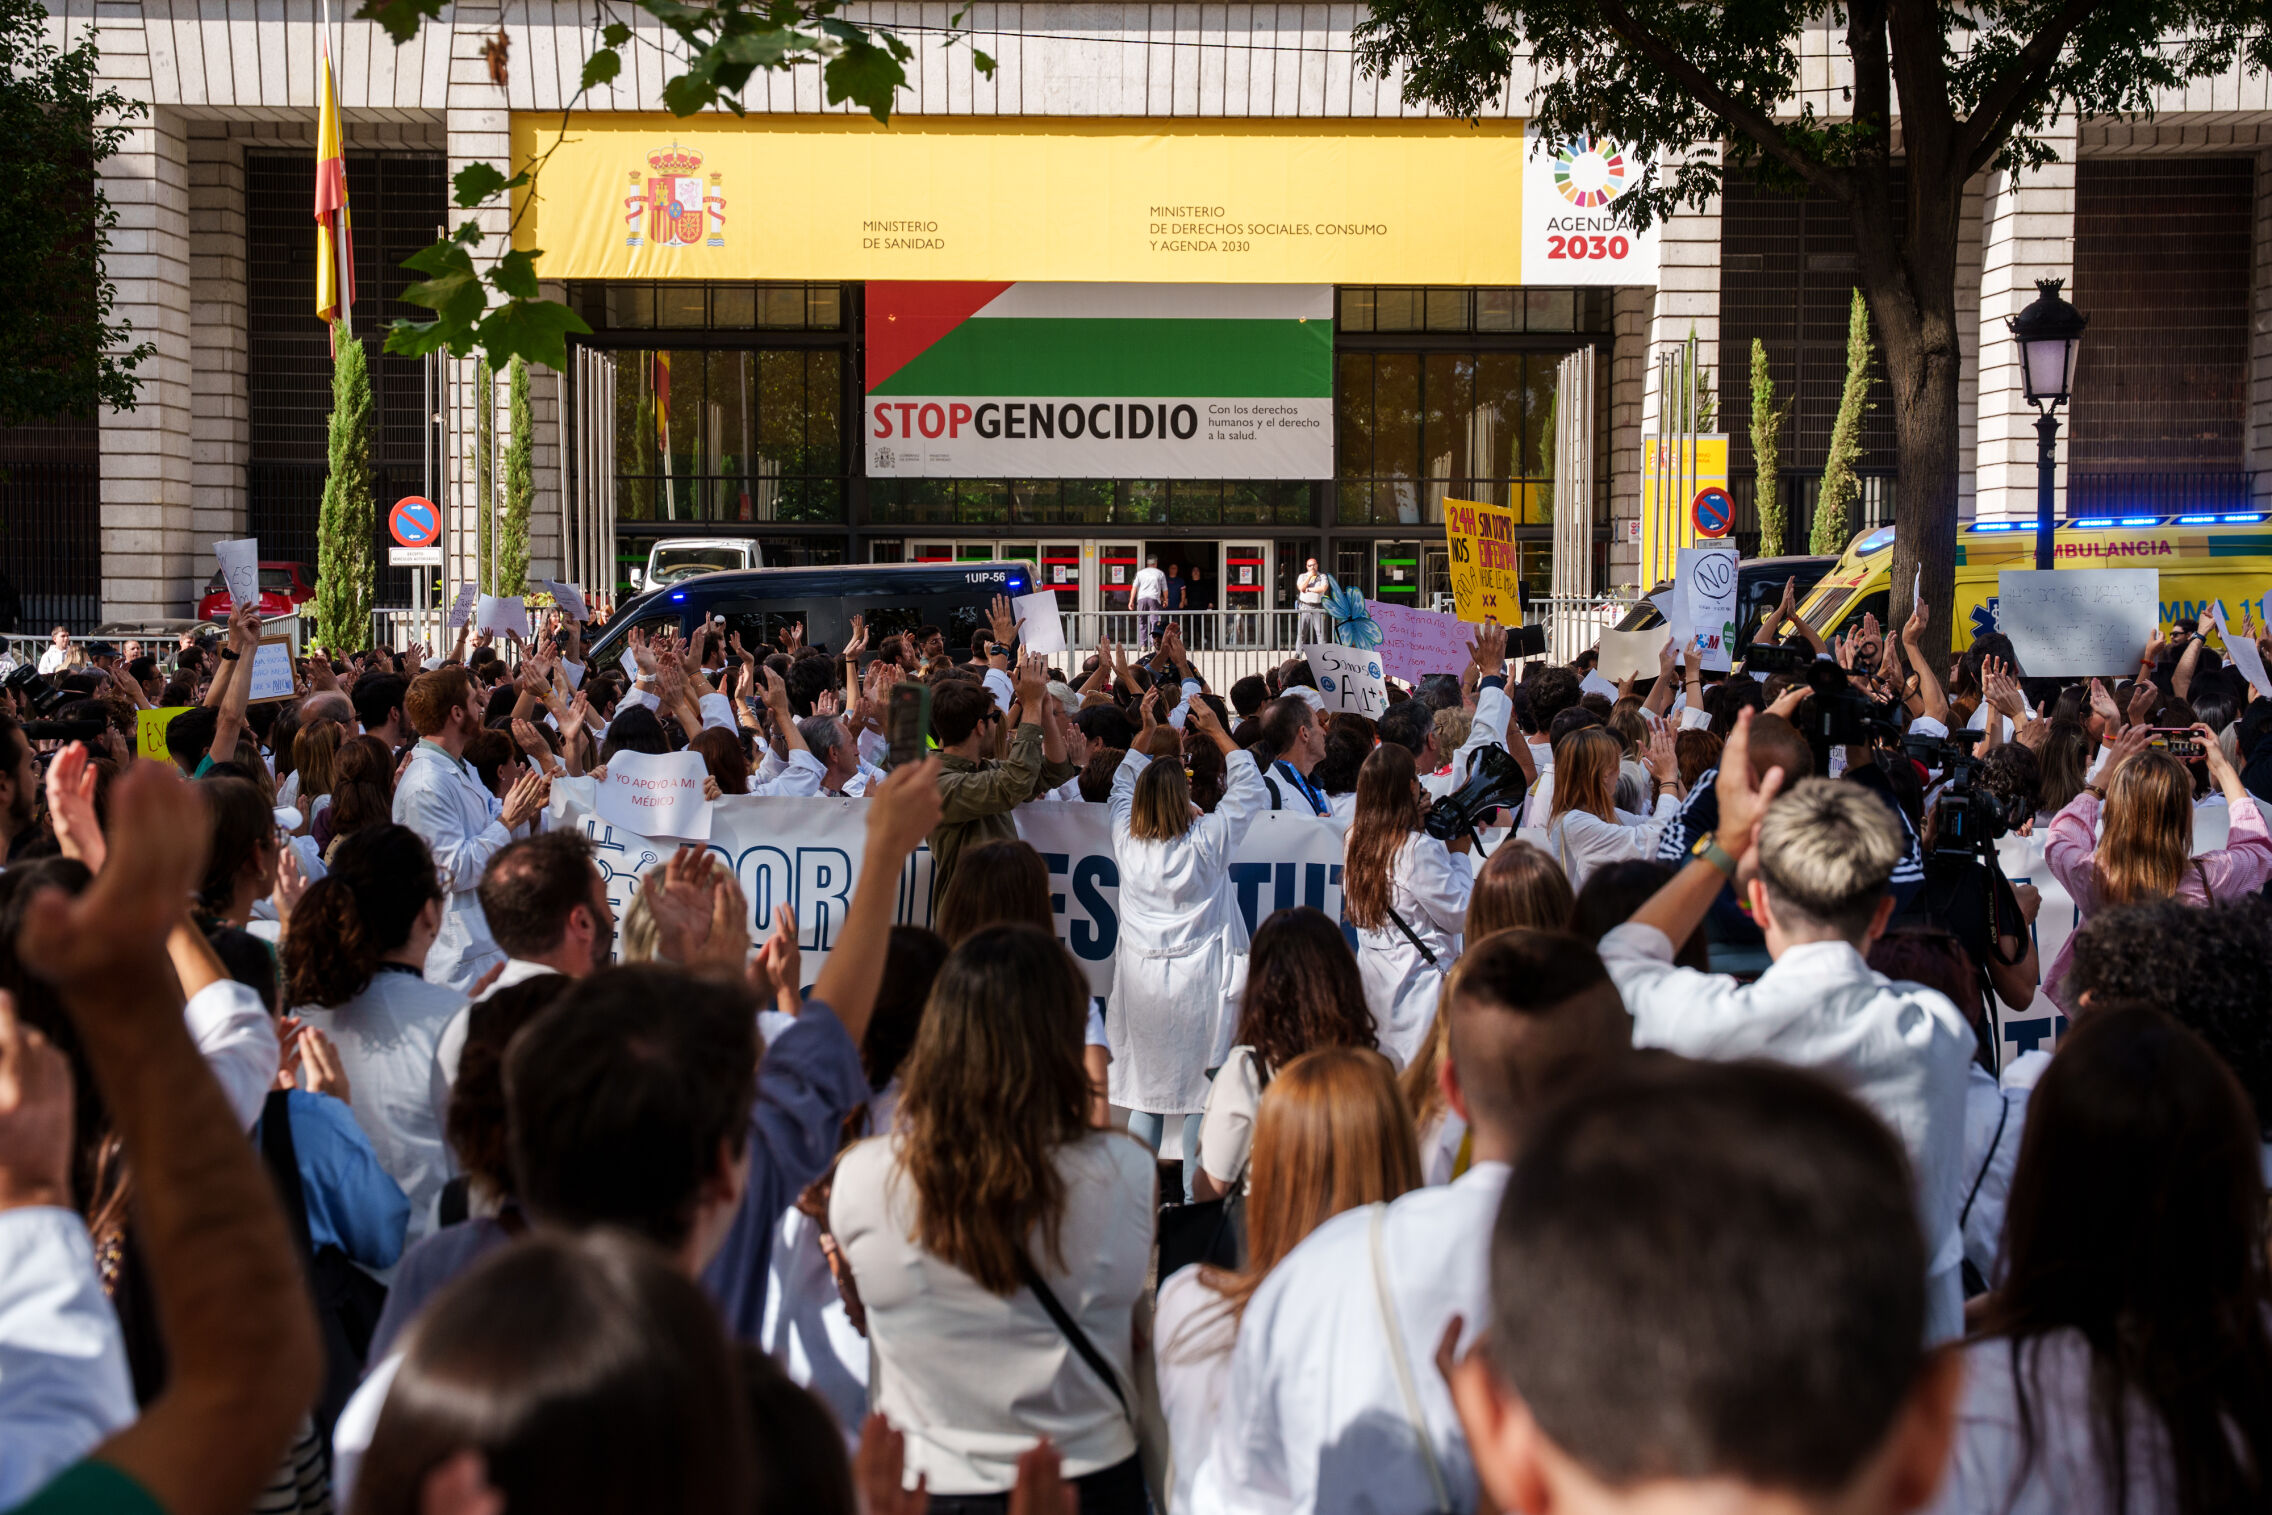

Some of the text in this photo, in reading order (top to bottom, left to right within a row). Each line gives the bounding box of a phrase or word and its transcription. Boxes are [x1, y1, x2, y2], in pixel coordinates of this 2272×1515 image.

[1150, 206, 1225, 218] MINISTERIO
[863, 221, 938, 232] MINISTERIO
[1150, 223, 1388, 236] DE DERECHOS SOCIALES, CONSUMO
[1546, 217, 1630, 231] AGENDA
[863, 238, 945, 250] DE SANIDAD
[1150, 241, 1250, 252] Y AGENDA 2030
[1547, 235, 1629, 259] 2030
[1208, 404, 1298, 415] Con los derechos
[873, 402, 1198, 439] STOPGENOCIDIO
[1208, 417, 1320, 429] humanos y el derecho
[1208, 430, 1257, 440] a la salud.
[1450, 506, 1476, 536] 24H
[1479, 512, 1492, 539] SIN
[1451, 537, 1470, 563] NOS
[2033, 540, 2172, 560] MBULANCIA
[965, 571, 1006, 583] 1UIP-56
[1697, 563, 1729, 591] NO
[2240, 599, 2264, 621] 11
[616, 773, 695, 789] YO APOYO A MI
[631, 795, 675, 807] MÉDICO
